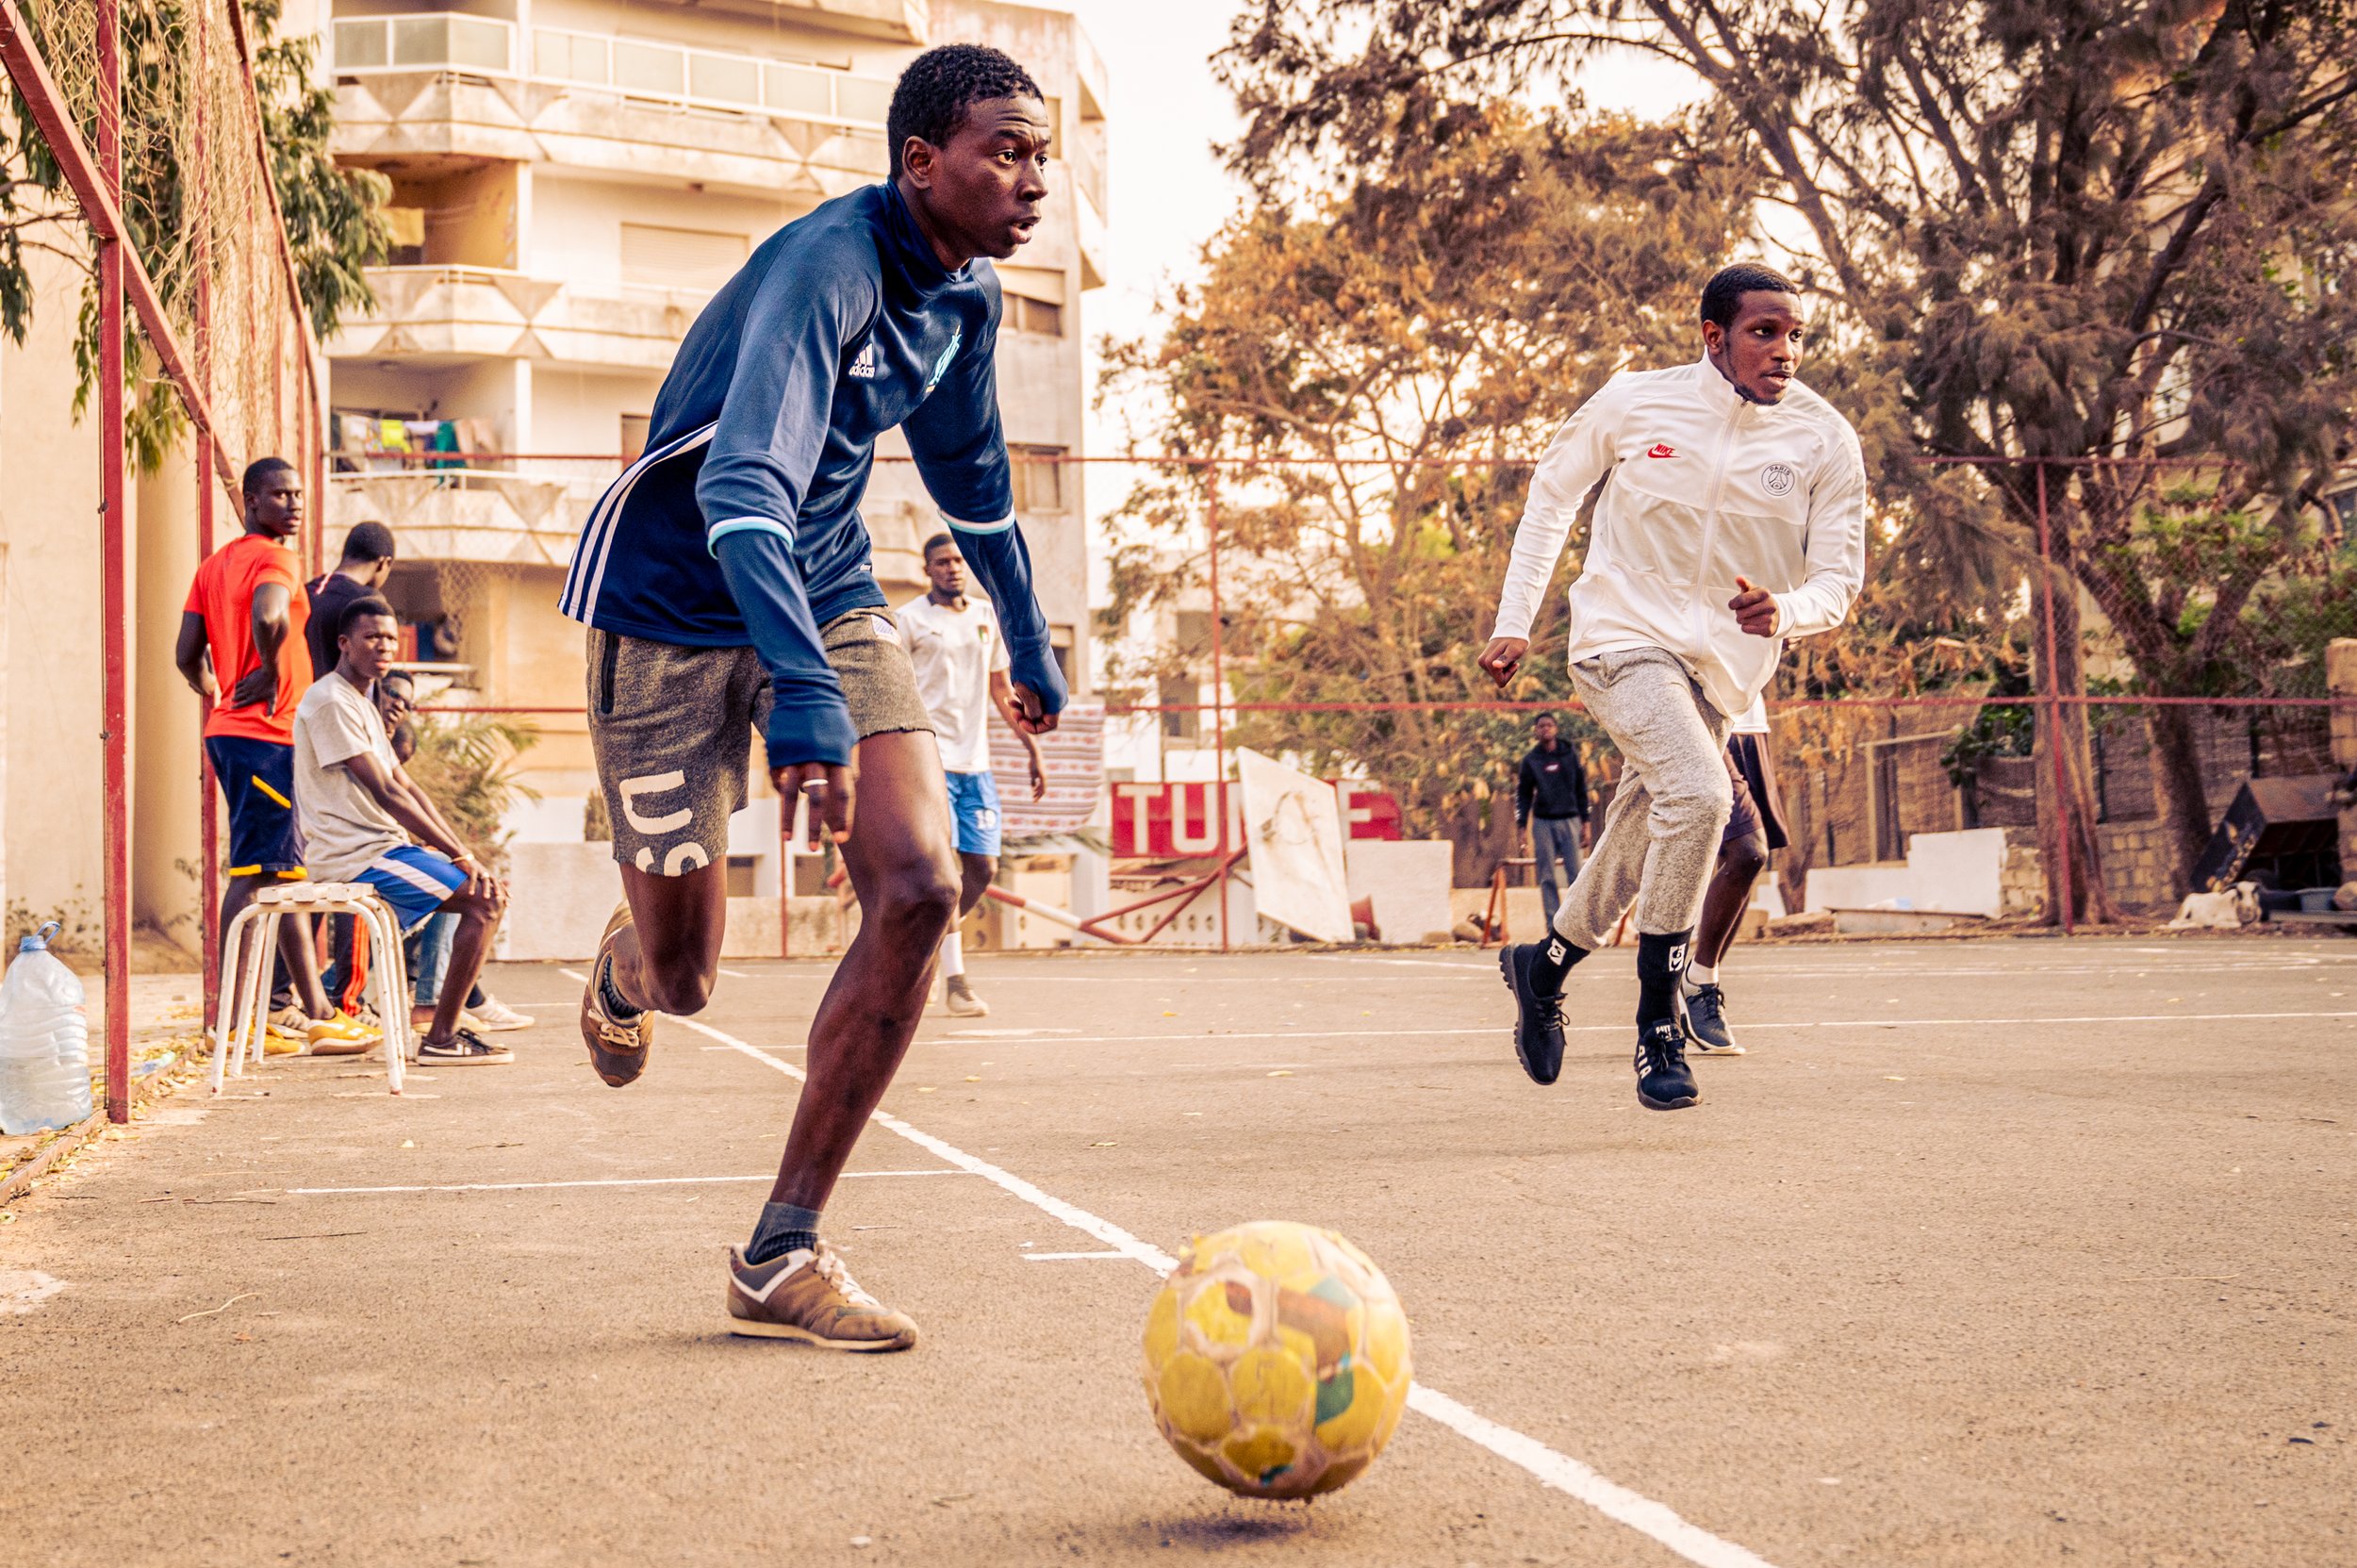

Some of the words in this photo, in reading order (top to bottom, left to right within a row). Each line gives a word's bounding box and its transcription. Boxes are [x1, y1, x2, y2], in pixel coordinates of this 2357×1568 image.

[849, 362, 876, 378] adidas
[1654, 443, 1675, 457] NIKE
[1769, 466, 1790, 476] PARIS
